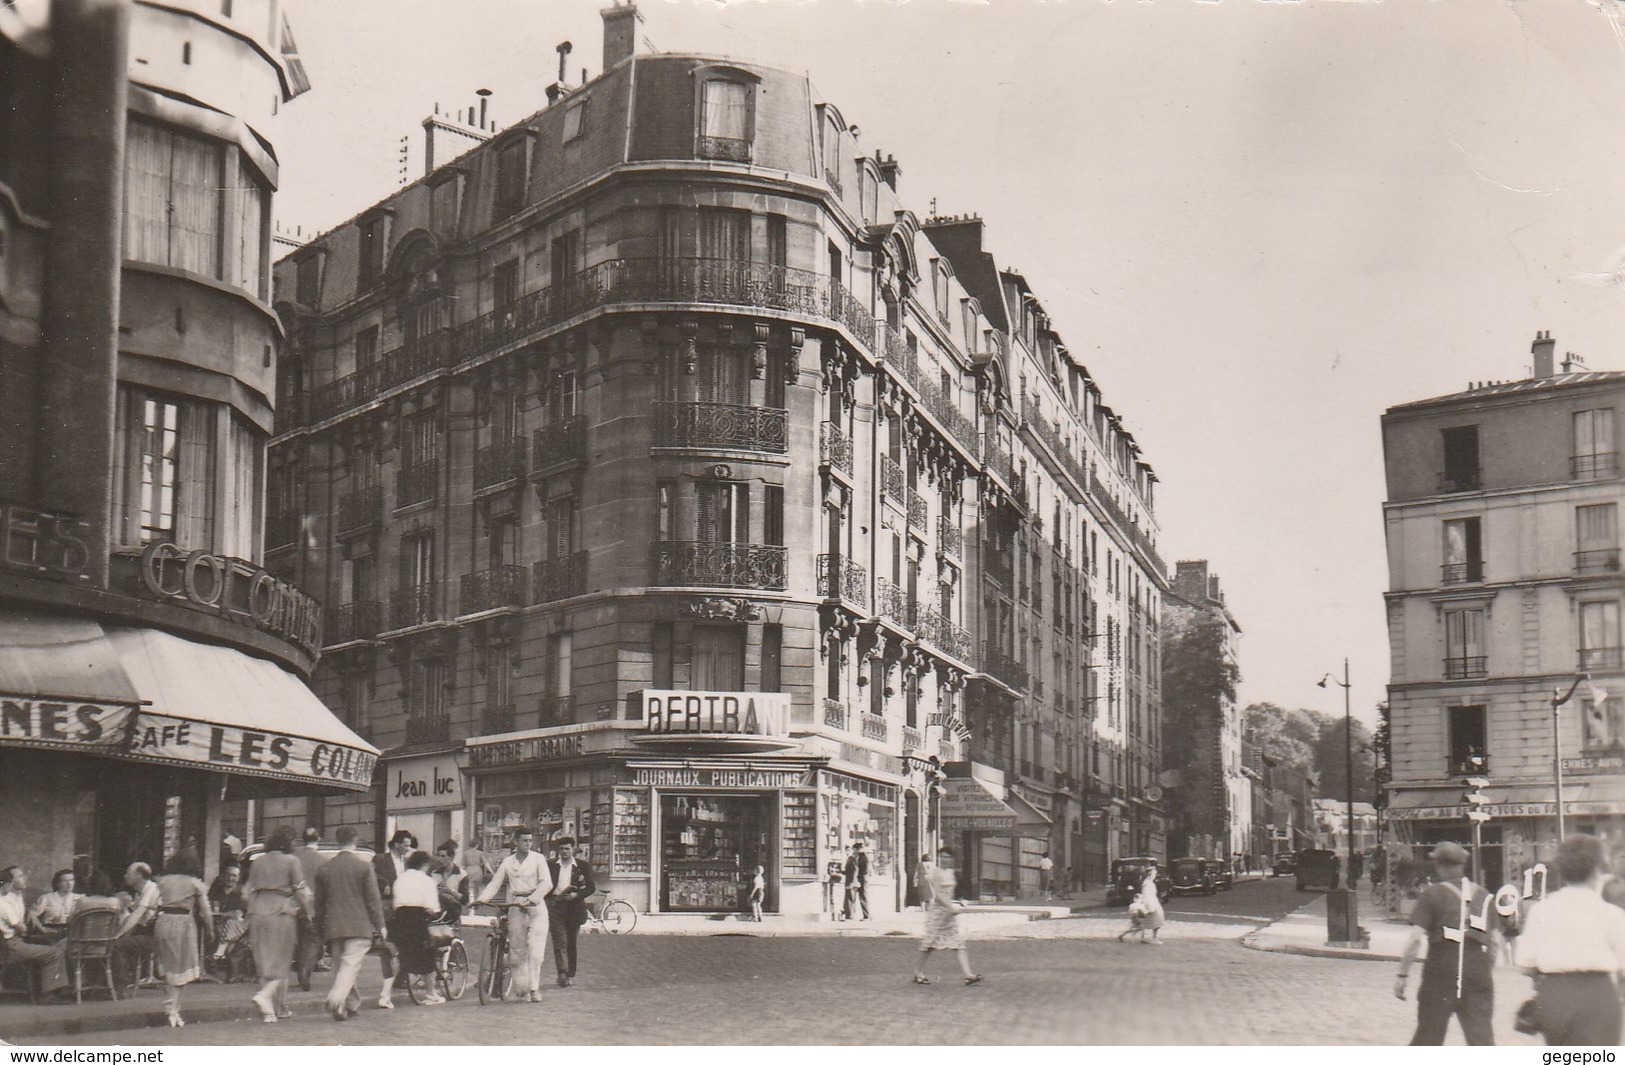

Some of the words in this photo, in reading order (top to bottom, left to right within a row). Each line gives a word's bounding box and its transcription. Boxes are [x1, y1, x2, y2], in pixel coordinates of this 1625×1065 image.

[209, 727, 293, 770] LES
[531, 735, 585, 760] LIBRAIRIE
[395, 770, 426, 798] Jean
[632, 769, 700, 786] JOURNAUX
[711, 771, 800, 788] PUBLICATIONS
